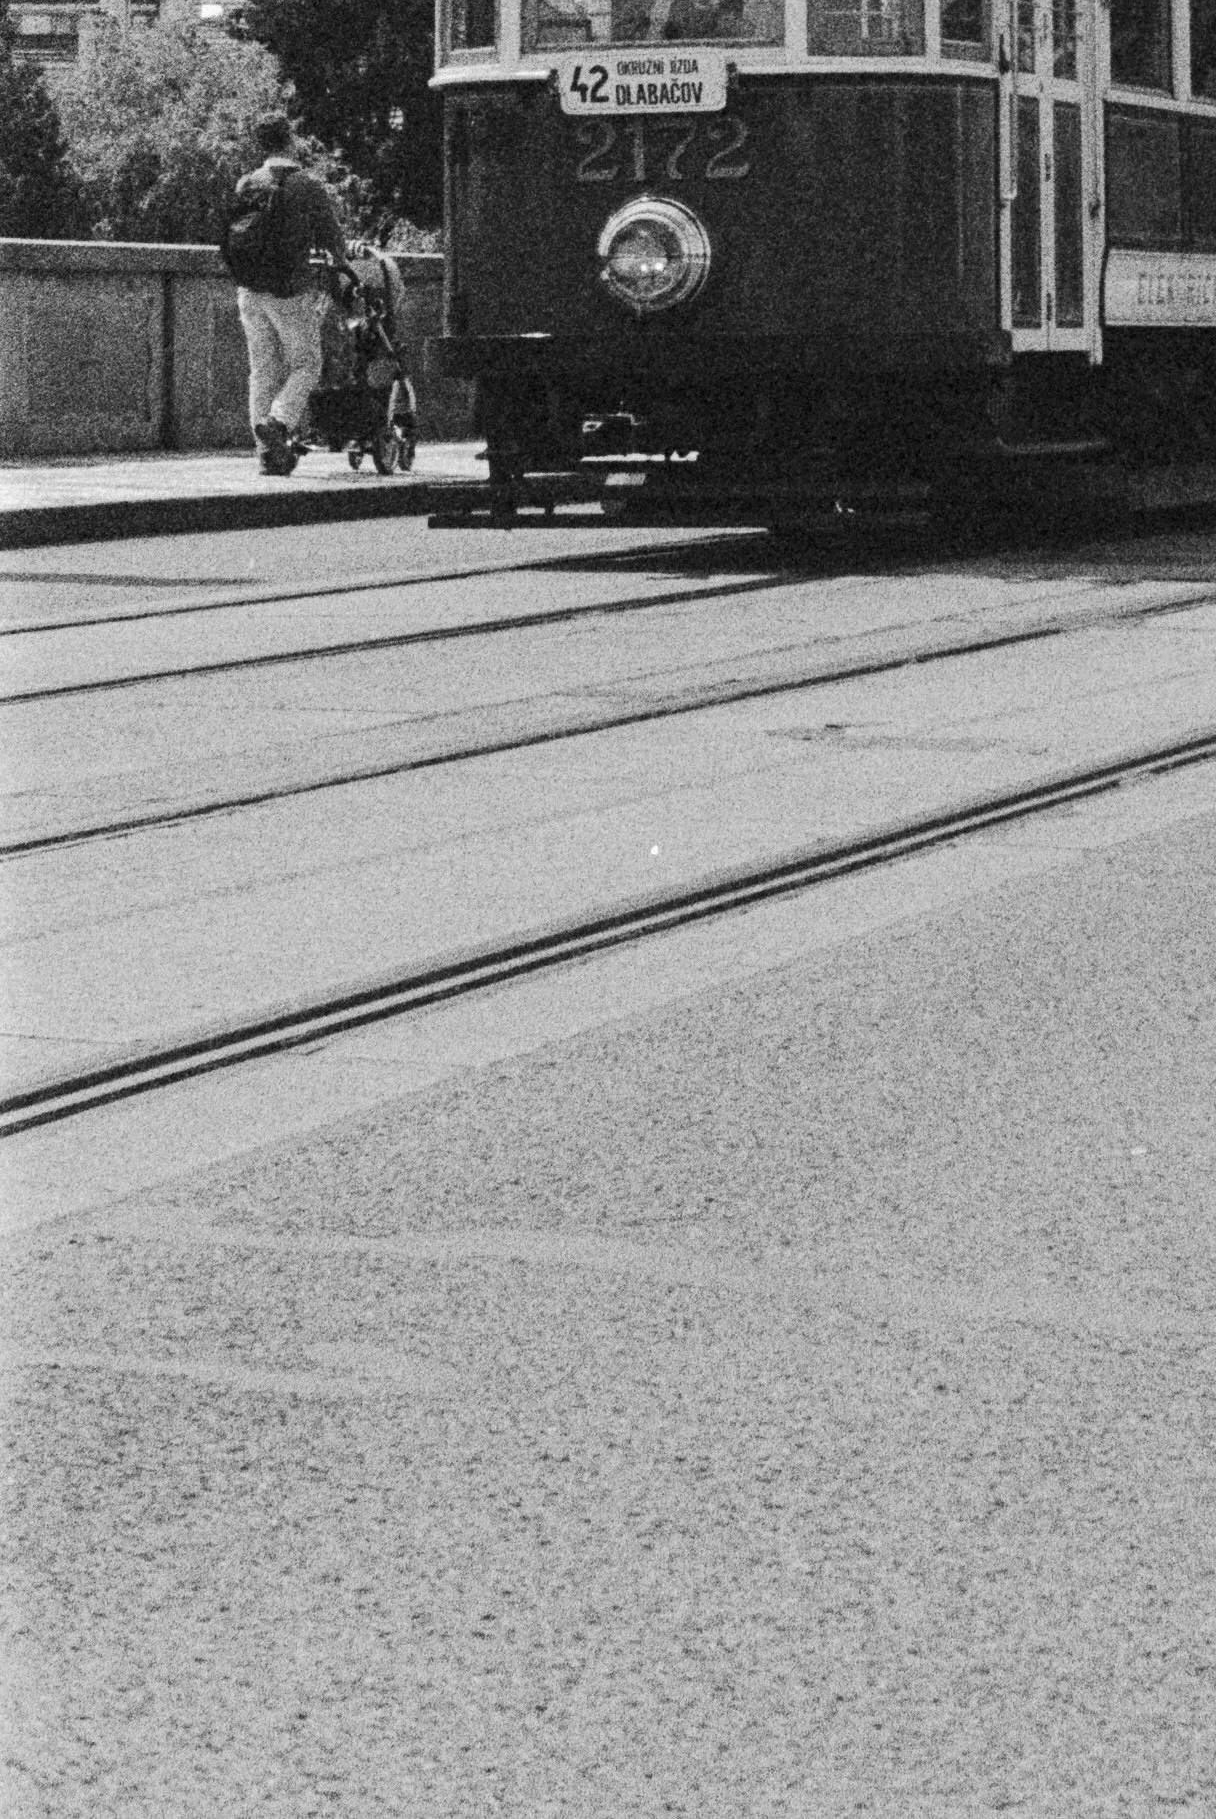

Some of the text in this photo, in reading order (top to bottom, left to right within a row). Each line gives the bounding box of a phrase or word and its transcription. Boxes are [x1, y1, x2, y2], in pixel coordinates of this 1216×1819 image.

[570, 65, 610, 103] 42
[615, 78, 703, 105] DLABAČOV
[576, 116, 750, 181] 2172
